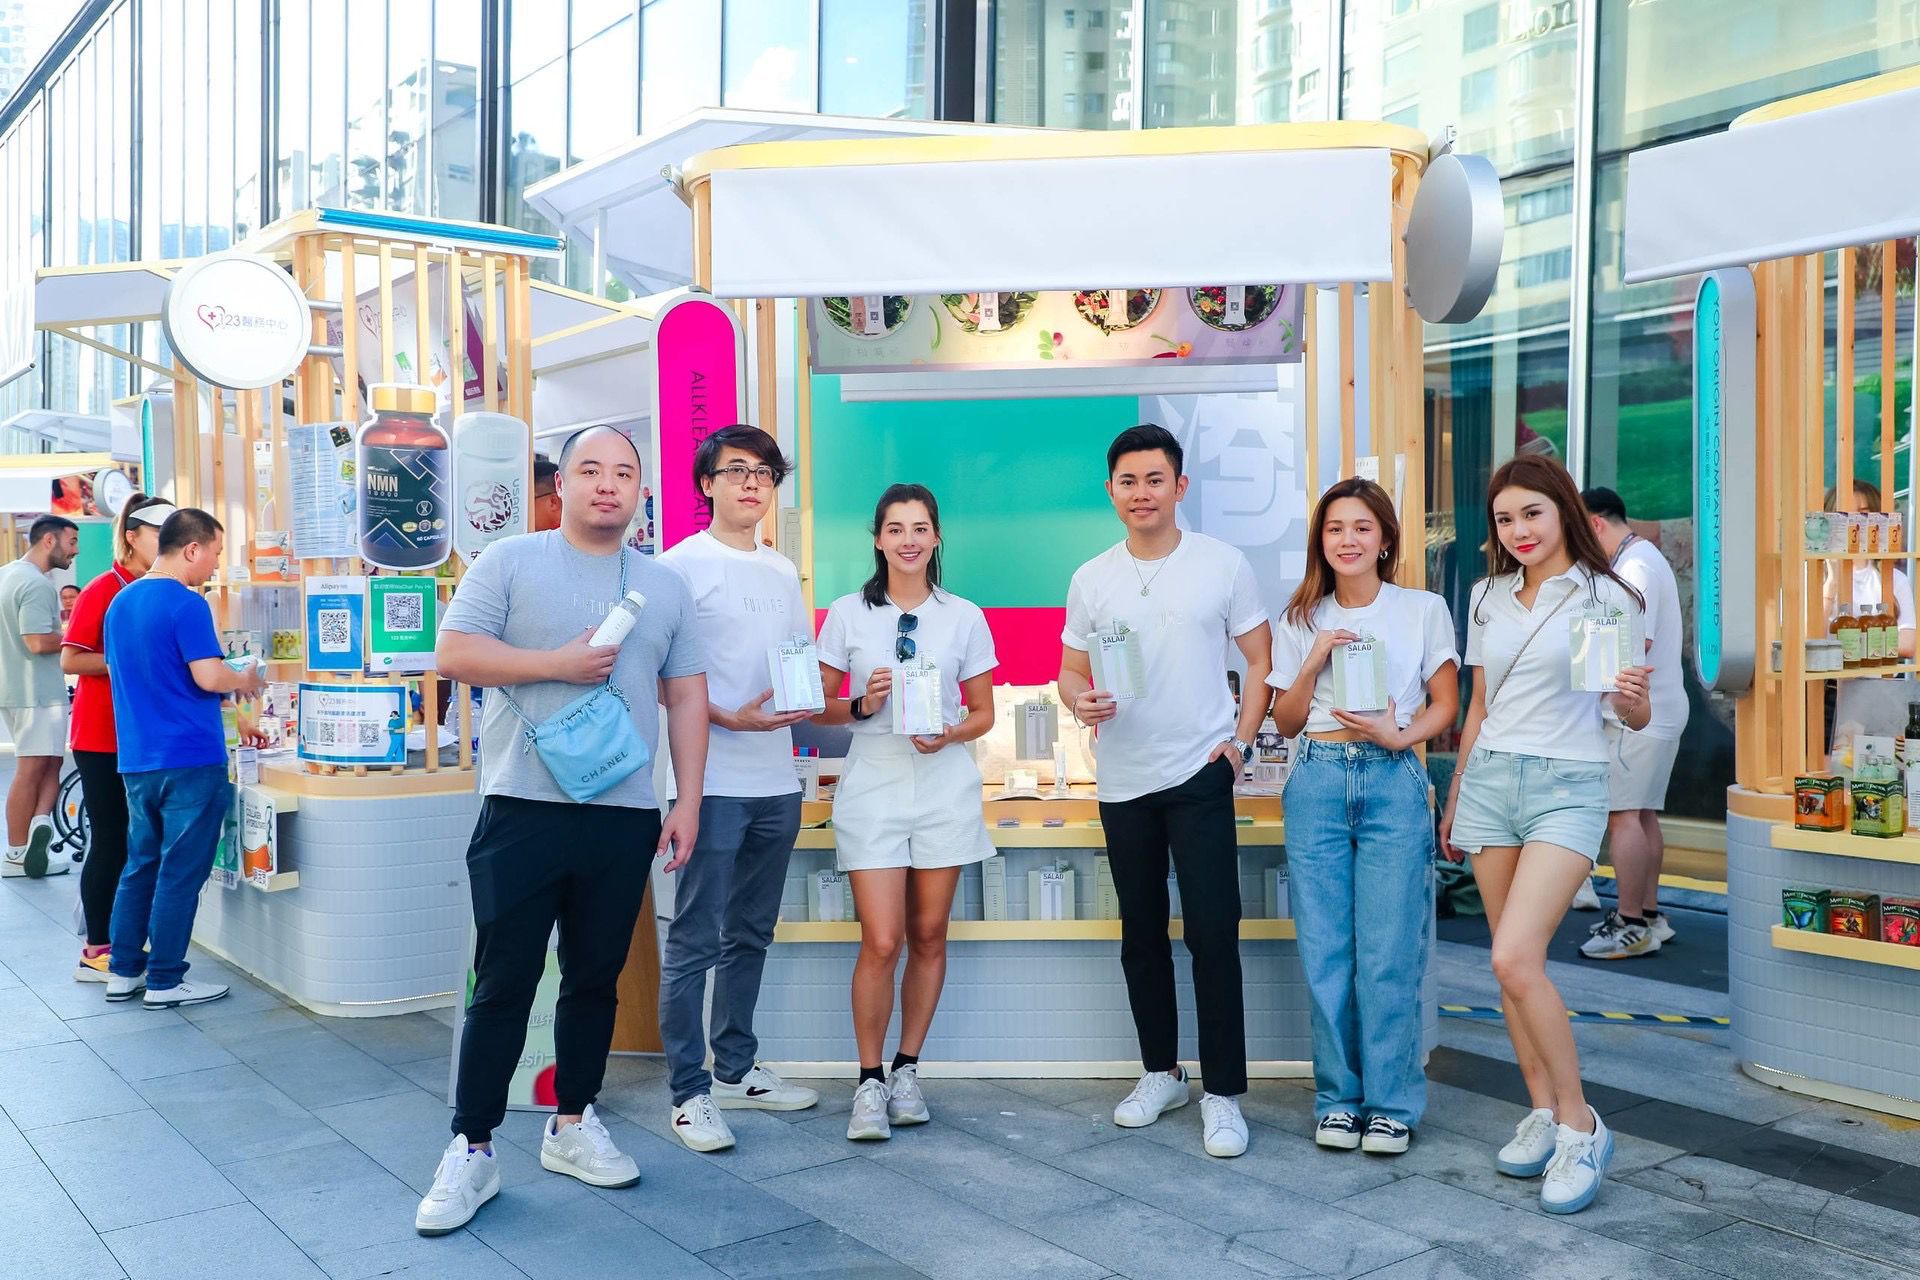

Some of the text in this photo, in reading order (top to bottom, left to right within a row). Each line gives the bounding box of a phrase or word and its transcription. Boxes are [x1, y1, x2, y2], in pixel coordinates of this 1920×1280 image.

[691, 371, 709, 457] ALLKLEA
[367, 473, 398, 492] NMN
[1102, 636, 1125, 644] SALAD
[581, 751, 629, 783] CHANEL
